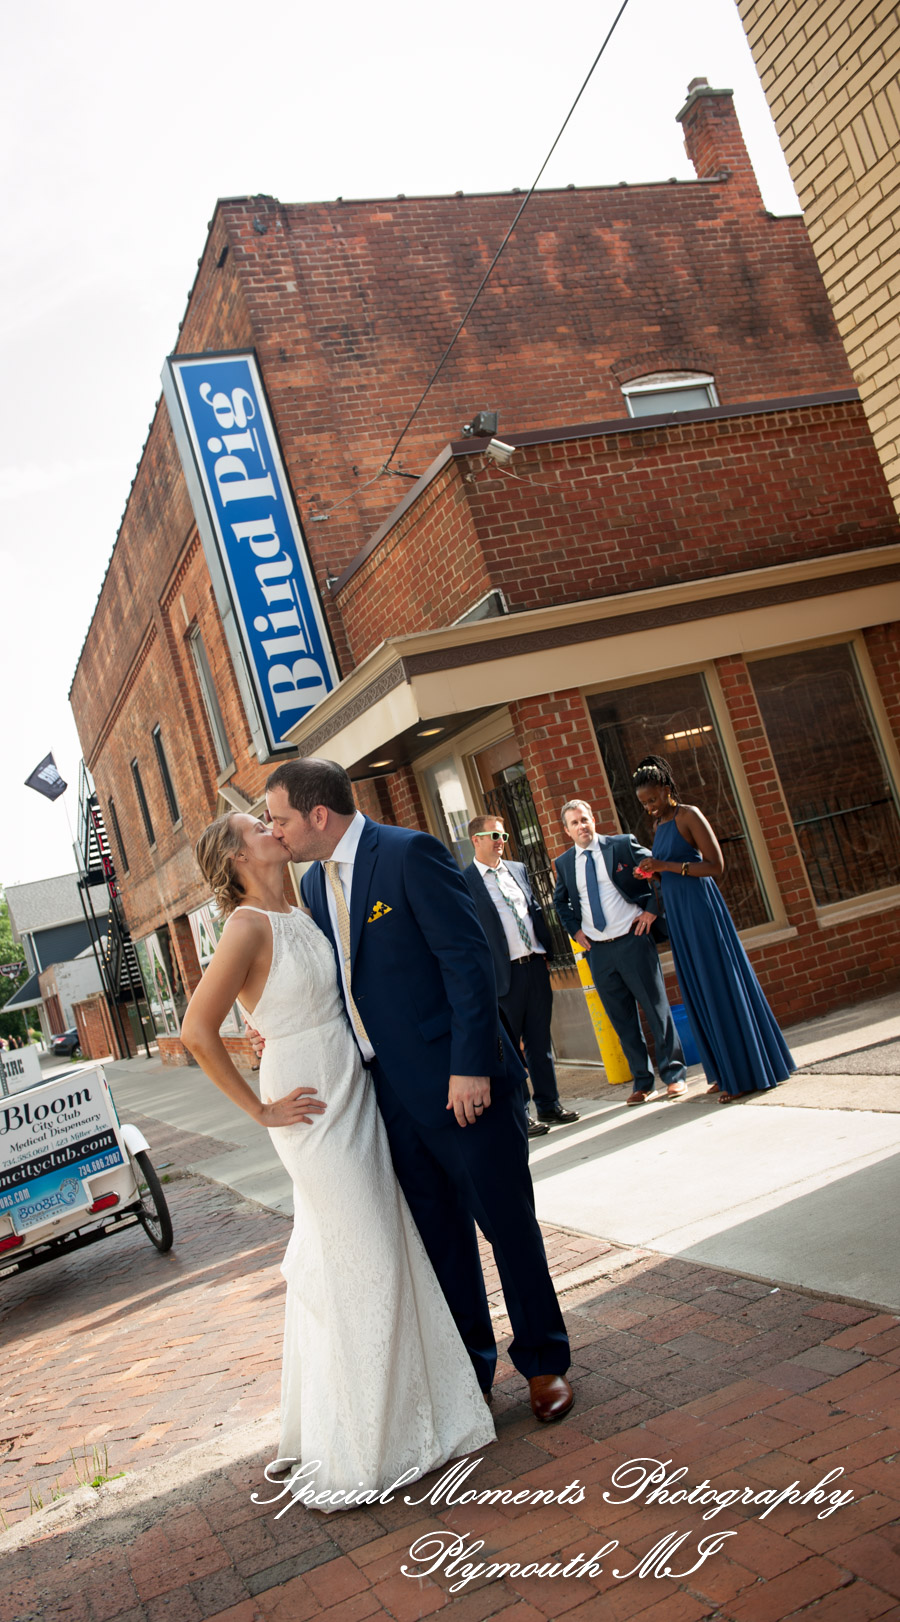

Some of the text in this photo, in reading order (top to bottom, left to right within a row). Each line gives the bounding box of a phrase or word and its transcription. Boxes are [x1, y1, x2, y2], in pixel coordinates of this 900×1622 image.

[199, 382, 328, 718] Blind Pig
[0, 1088, 93, 1136] Bloom
[31, 1109, 81, 1134] City Club
[9, 1113, 101, 1154] Medical Dispensary
[18, 1191, 76, 1220] BOOBER
